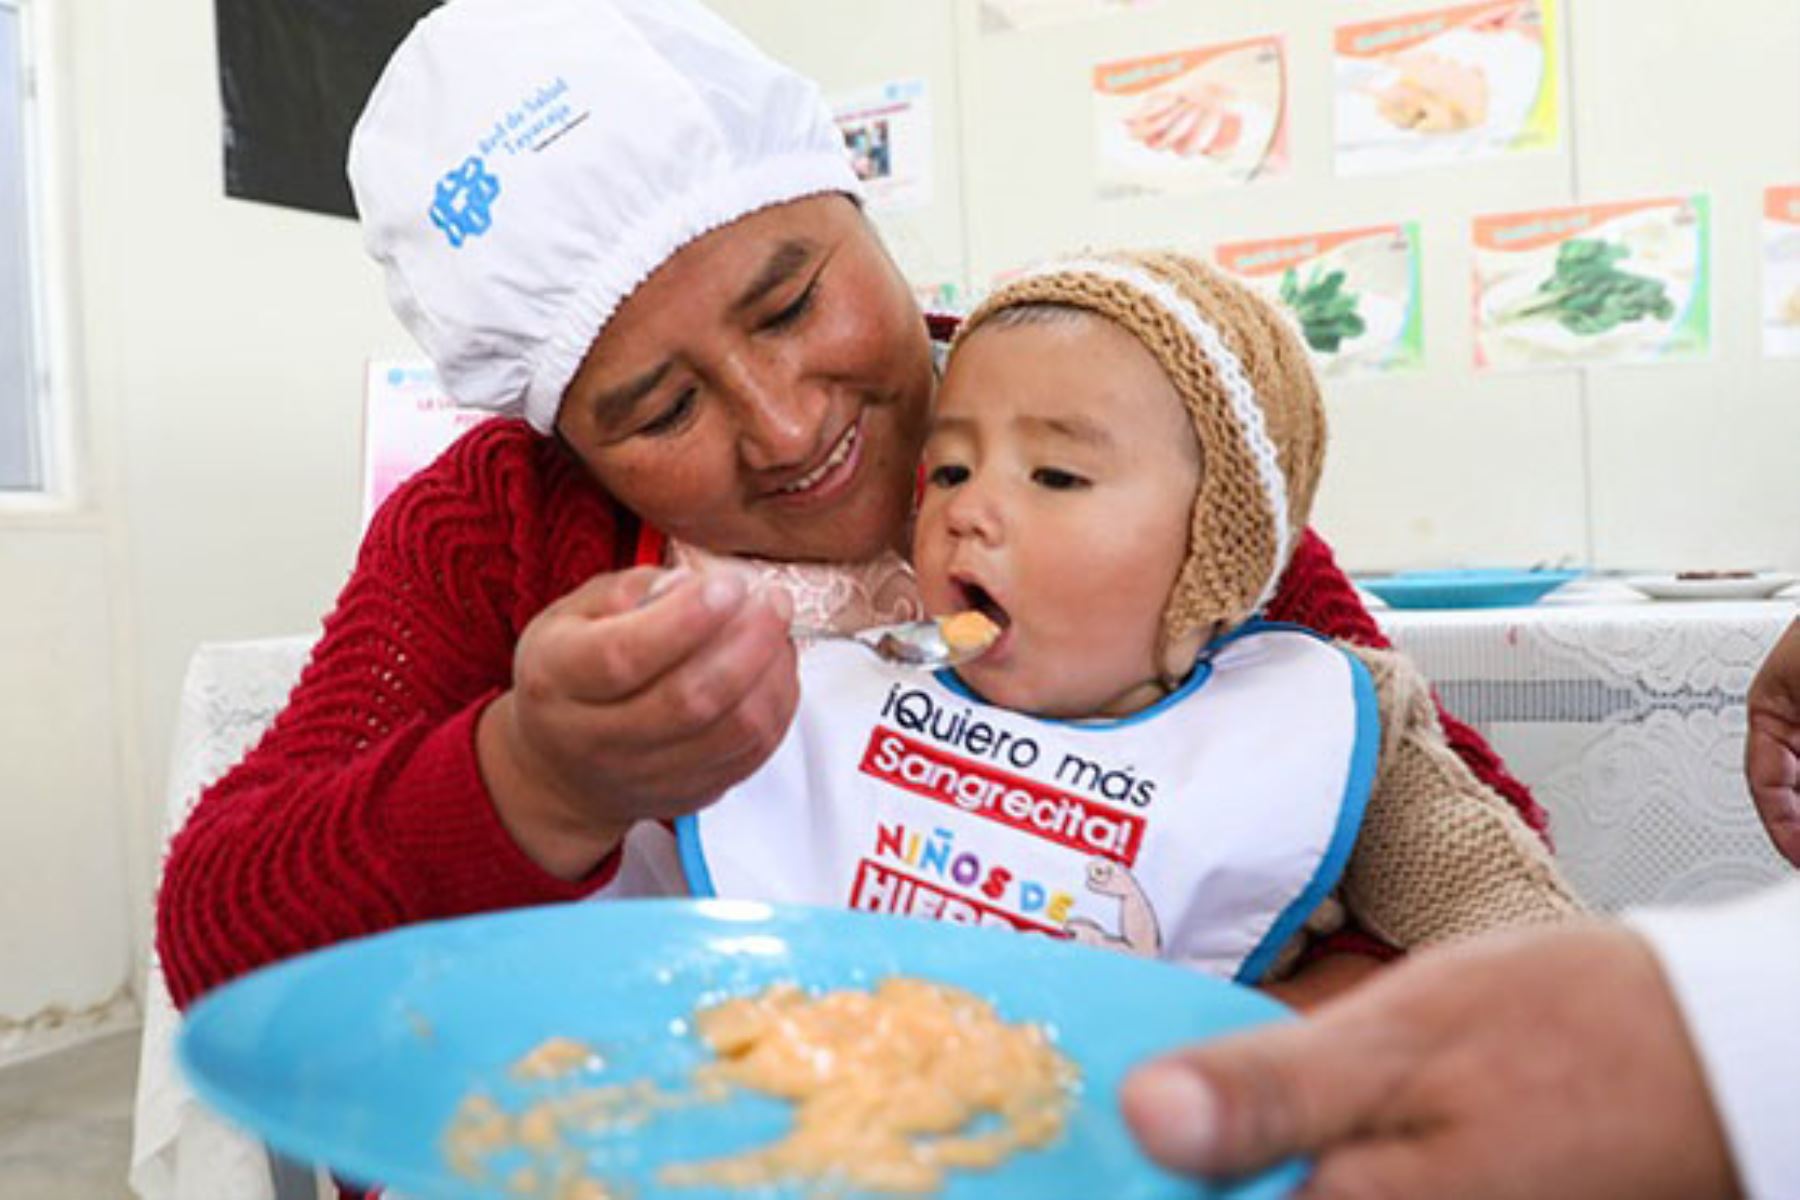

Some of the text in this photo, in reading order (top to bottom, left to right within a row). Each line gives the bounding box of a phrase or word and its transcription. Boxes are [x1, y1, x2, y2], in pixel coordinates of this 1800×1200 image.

[873, 737, 1131, 856] Sangrecita!
[1054, 753, 1156, 807] más
[876, 822, 1075, 922] NIÑOS DE
